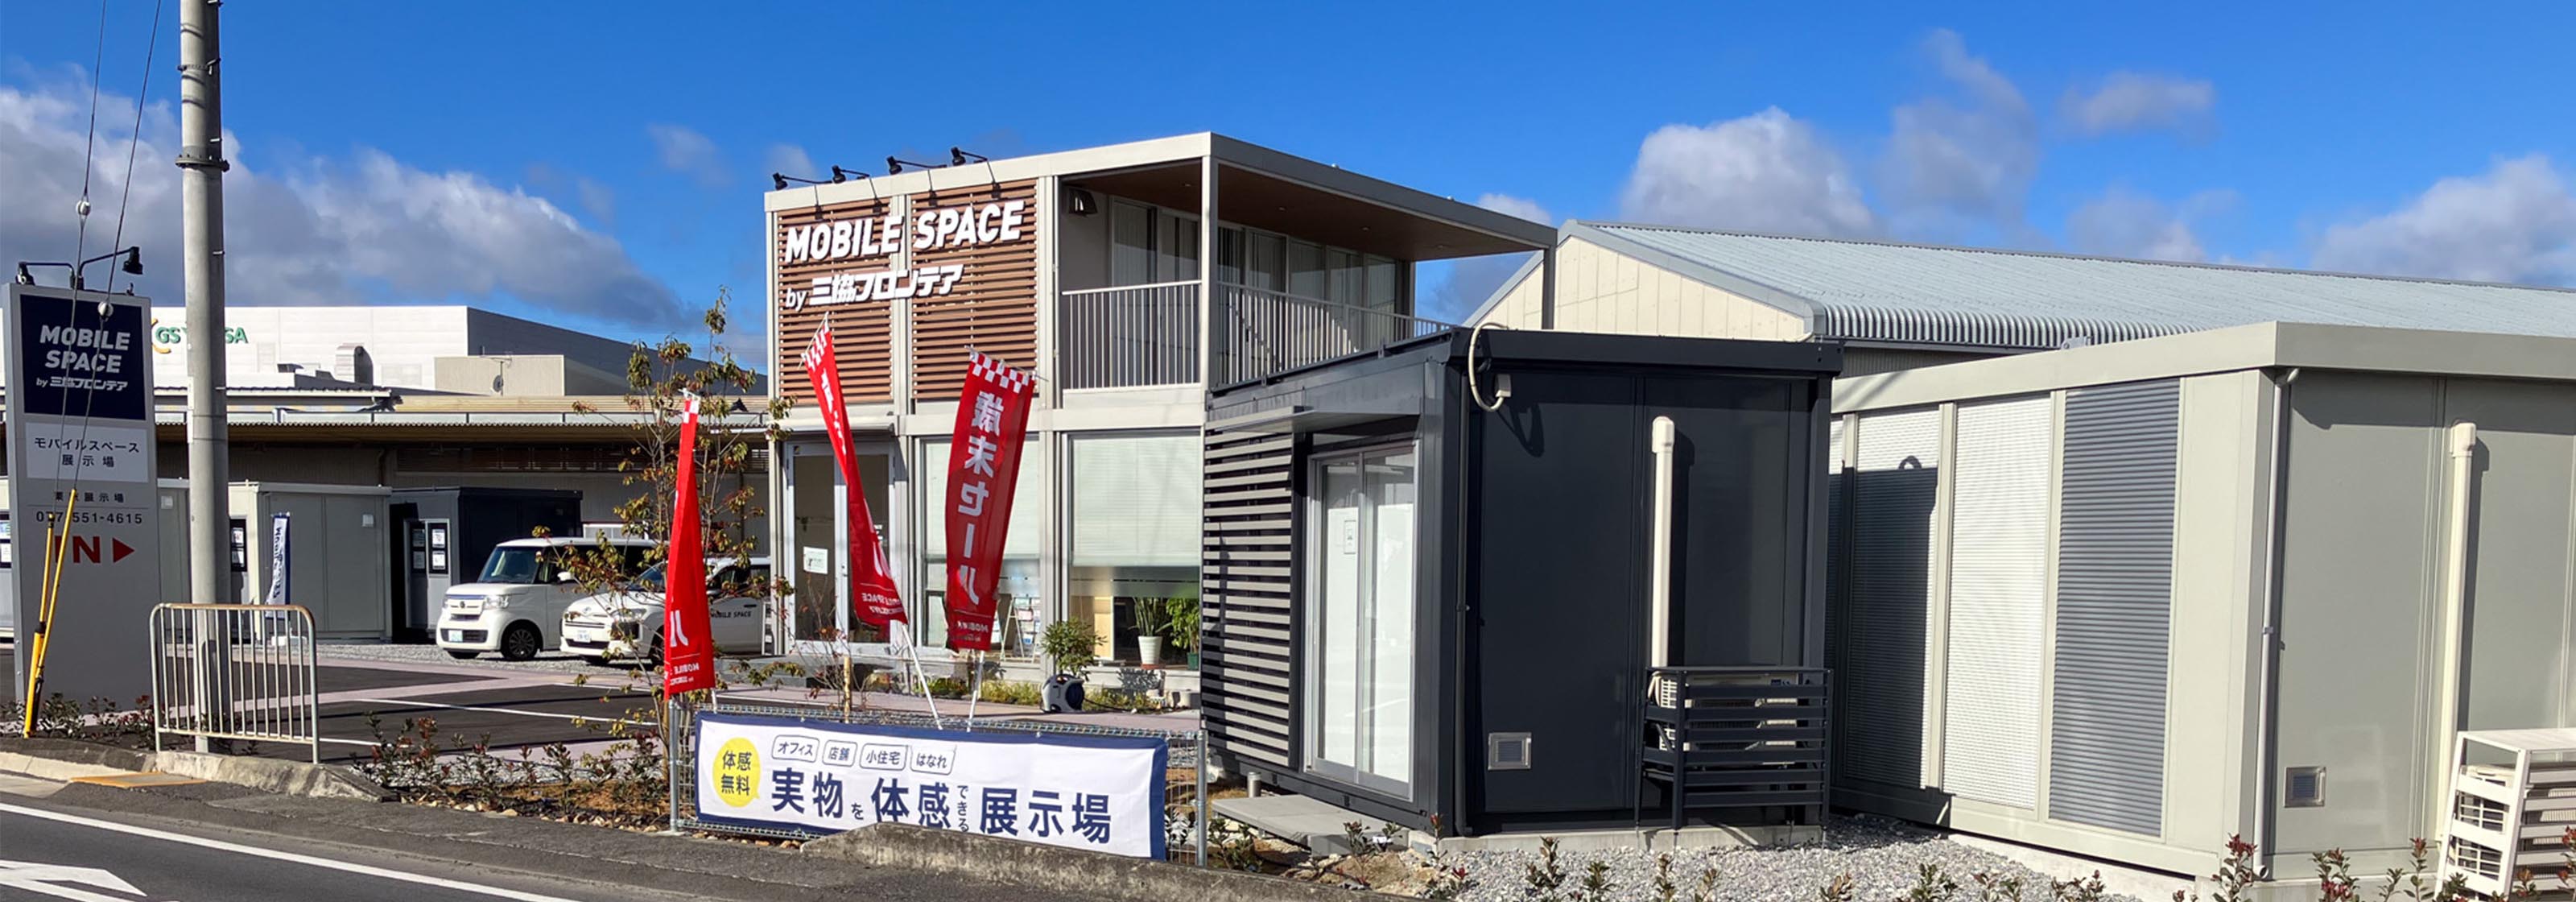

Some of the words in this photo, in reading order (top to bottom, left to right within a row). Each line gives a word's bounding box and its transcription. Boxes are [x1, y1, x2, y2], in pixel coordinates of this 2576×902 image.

[784, 215, 906, 264] MOBILE
[912, 200, 1026, 250] SPACE
[785, 288, 807, 312] by
[809, 263, 964, 306] 三協フロンテア
[39, 325, 131, 350] MOBILE
[44, 350, 122, 373] SPACE
[36, 377, 48, 387] by
[35, 437, 139, 453] モバイルスペース
[62, 453, 114, 467] 展示場
[722, 750, 751, 771] 体感
[777, 741, 814, 757] オフィス
[828, 746, 849, 761] 店舗
[865, 749, 902, 765] 小住宅
[915, 752, 947, 768] はなれ
[720, 773, 750, 796] 無料
